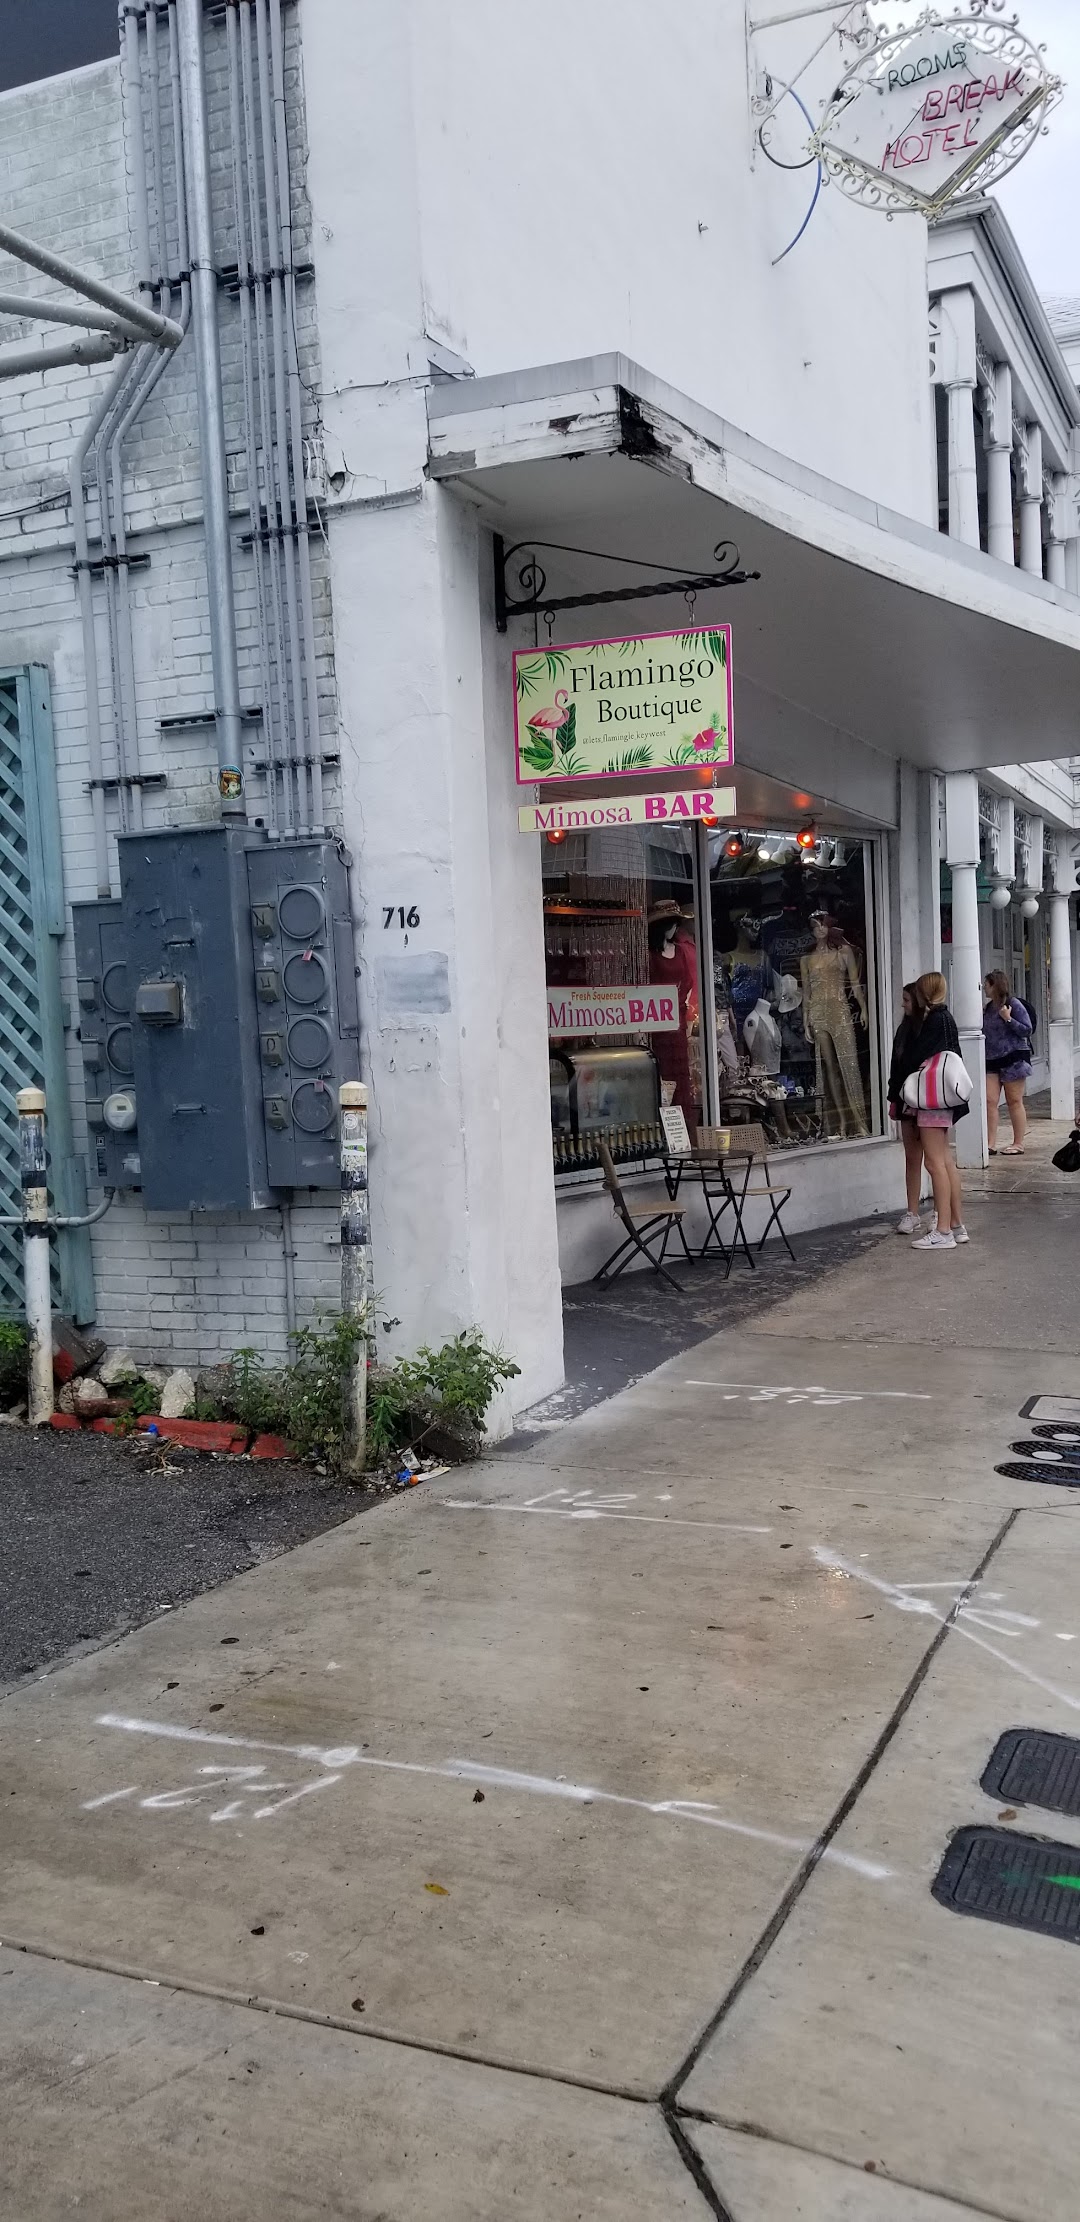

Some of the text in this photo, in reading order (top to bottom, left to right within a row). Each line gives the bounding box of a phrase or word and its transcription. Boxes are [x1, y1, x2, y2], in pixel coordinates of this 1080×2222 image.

[888, 42, 967, 91] ROOMS
[922, 67, 1025, 121] BREAK
[882, 118, 979, 171] HOTEL
[569, 657, 714, 693] Flamingo
[597, 695, 703, 724] Boutique
[533, 792, 716, 830] Mimosa BAR
[382, 905, 420, 929] 716
[547, 998, 675, 1029] Mimosa BAR
[571, 991, 626, 1003] Fresh Squeezed
